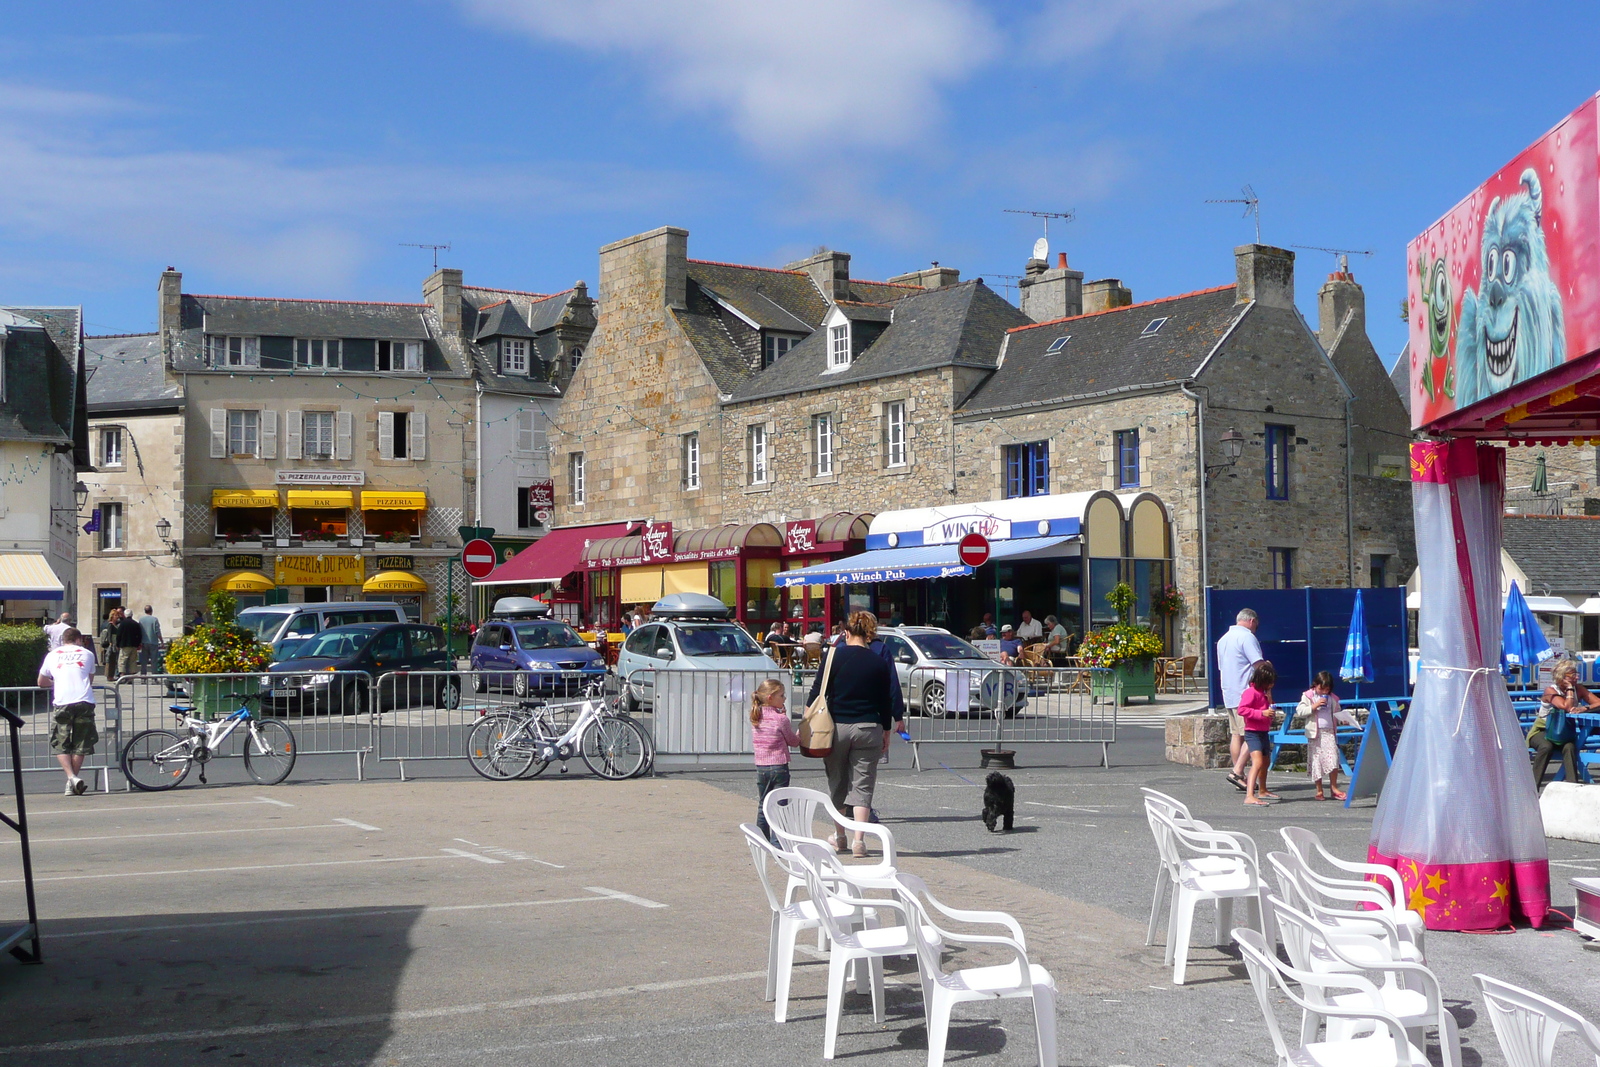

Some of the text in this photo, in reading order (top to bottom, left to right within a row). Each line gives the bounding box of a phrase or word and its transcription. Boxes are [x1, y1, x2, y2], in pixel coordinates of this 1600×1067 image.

[643, 526, 668, 543] Auberge
[788, 523, 811, 538] Auberge
[653, 541, 671, 558] Quai
[797, 536, 815, 550] Quai
[225, 555, 261, 567] CREPERIE
[378, 556, 412, 568] PIZZERIA
[602, 558, 611, 566] Pub
[616, 557, 642, 566] Restaurant
[700, 551, 715, 560] Fruits
[278, 556, 360, 573] PIZZERIA DU PORT
[836, 570, 906, 582] Le Winch Pub
